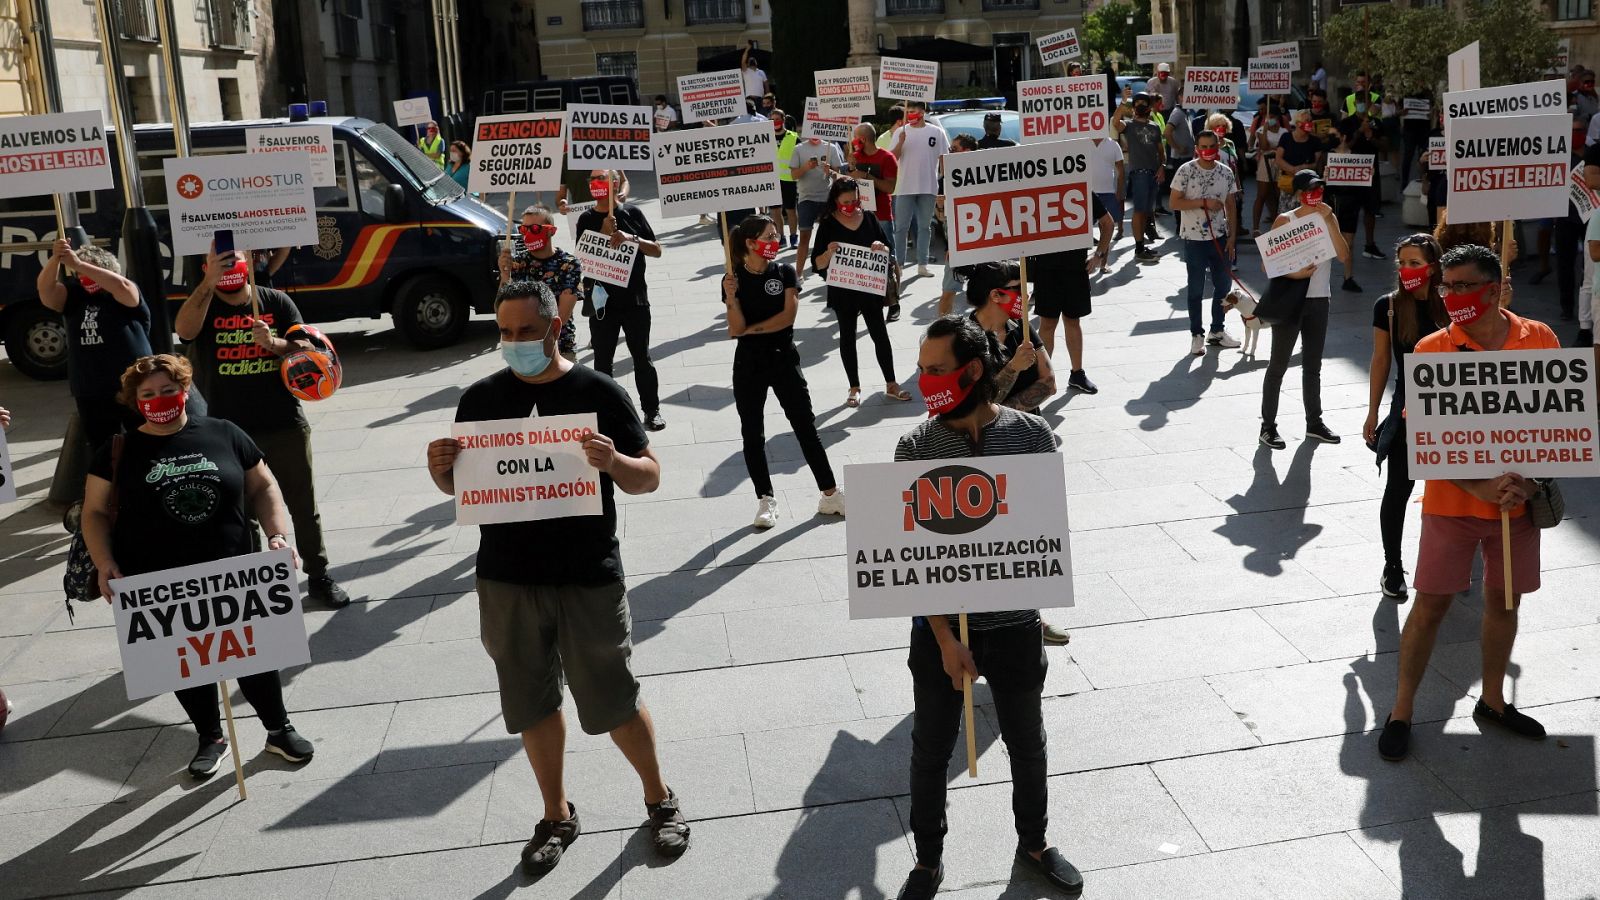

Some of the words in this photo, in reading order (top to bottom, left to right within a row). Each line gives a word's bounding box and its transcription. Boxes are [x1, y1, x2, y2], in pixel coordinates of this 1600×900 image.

[1040, 34, 1065, 46] AYUDAS
[1043, 46, 1078, 61] LOCALES
[1188, 71, 1238, 82] RESCATE
[842, 84, 869, 92] CULTURA
[1022, 86, 1053, 96] SOMOS
[1056, 85, 1065, 93] EL
[1068, 82, 1102, 92] SECTOR
[1194, 85, 1213, 93] PARA
[1215, 85, 1230, 93] LOS
[690, 98, 737, 112] ¡REAPERTURA
[696, 106, 734, 118] INMEDIATA!
[1022, 96, 1072, 114] MOTOR
[1078, 94, 1104, 108] DEL
[1449, 96, 1528, 118] SALVEMOS
[1533, 92, 1562, 109] LOS
[572, 112, 628, 125] AYUDAS
[632, 113, 649, 125] AL
[1023, 111, 1105, 137] EMPLEO
[0, 128, 76, 148] ALVEMOS
[81, 126, 102, 141] LA
[478, 117, 560, 140] EXENCIÓN
[572, 128, 631, 141] ALQUILER
[634, 129, 650, 140] DE
[259, 135, 320, 146] #SALVEMOS
[658, 144, 672, 158] ¿Y
[676, 137, 734, 153] NUESTRO
[738, 133, 770, 146] PLAN
[929, 137, 936, 147] G
[1455, 136, 1542, 159] SALVEMOS
[1547, 136, 1567, 154] LA
[491, 143, 542, 157] CUOTAS
[573, 144, 650, 160] LOCALES
[675, 155, 691, 166] DE
[695, 147, 755, 163] RESCATE?
[479, 157, 552, 172] SEGURIDAD
[952, 159, 1047, 187] SALVEMOS
[1053, 154, 1087, 176] LOS
[208, 173, 304, 191] CONHOSTUR
[490, 172, 536, 186] SOCIAL
[661, 175, 681, 184] OCIO
[683, 169, 728, 180] NOCTURNO
[736, 164, 773, 174] TURISMO
[1329, 168, 1371, 180] BARES
[663, 189, 720, 204] ¡QUEREMOS
[723, 183, 775, 196] TRABAJAR!
[181, 205, 306, 223] #SALVEMOSLAHOSTELERÍA
[956, 189, 1086, 244] BARES
[1268, 221, 1315, 247] #SALVEMOS
[581, 233, 634, 254] QUEREOS
[578, 243, 630, 264] TRABAJAR
[835, 246, 888, 265] QUEREMOS
[595, 262, 628, 275] NOCTURNO
[835, 256, 886, 274] TRABAJAR
[596, 270, 626, 282] CULPABLE
[856, 273, 886, 284] NOCTURNO
[214, 314, 274, 329] adids
[80, 336, 104, 345] LOLA
[1413, 358, 1588, 389] QUEREMOS
[1418, 388, 1585, 416] TRABAJAR
[457, 432, 524, 450] EXIGIMOS
[528, 426, 592, 445] DIÁLOGO
[1416, 432, 1436, 446] EL
[1442, 430, 1485, 445] OCIO
[1491, 428, 1591, 444] NOCTURNO
[1416, 451, 1441, 465] NO
[1447, 451, 1468, 464] ES
[1475, 450, 1495, 464] EL
[1500, 448, 1593, 463] CULPABLE
[146, 457, 219, 484] Mundo
[497, 459, 530, 475] CON
[534, 457, 554, 472] LA
[461, 477, 596, 505] ADMINISTRACIÓN
[902, 473, 1008, 532] ¡NO!
[855, 550, 867, 564] A
[872, 548, 895, 563] LA
[900, 535, 1061, 562] CULPABILIZACIÓN
[857, 570, 885, 588] DE
[892, 567, 919, 586] LA
[926, 555, 1063, 584] HOSTELERÍA
[120, 562, 289, 610] NECESITAMOS
[127, 583, 294, 645] AYUDAS
[177, 625, 256, 678] ¡YA!
